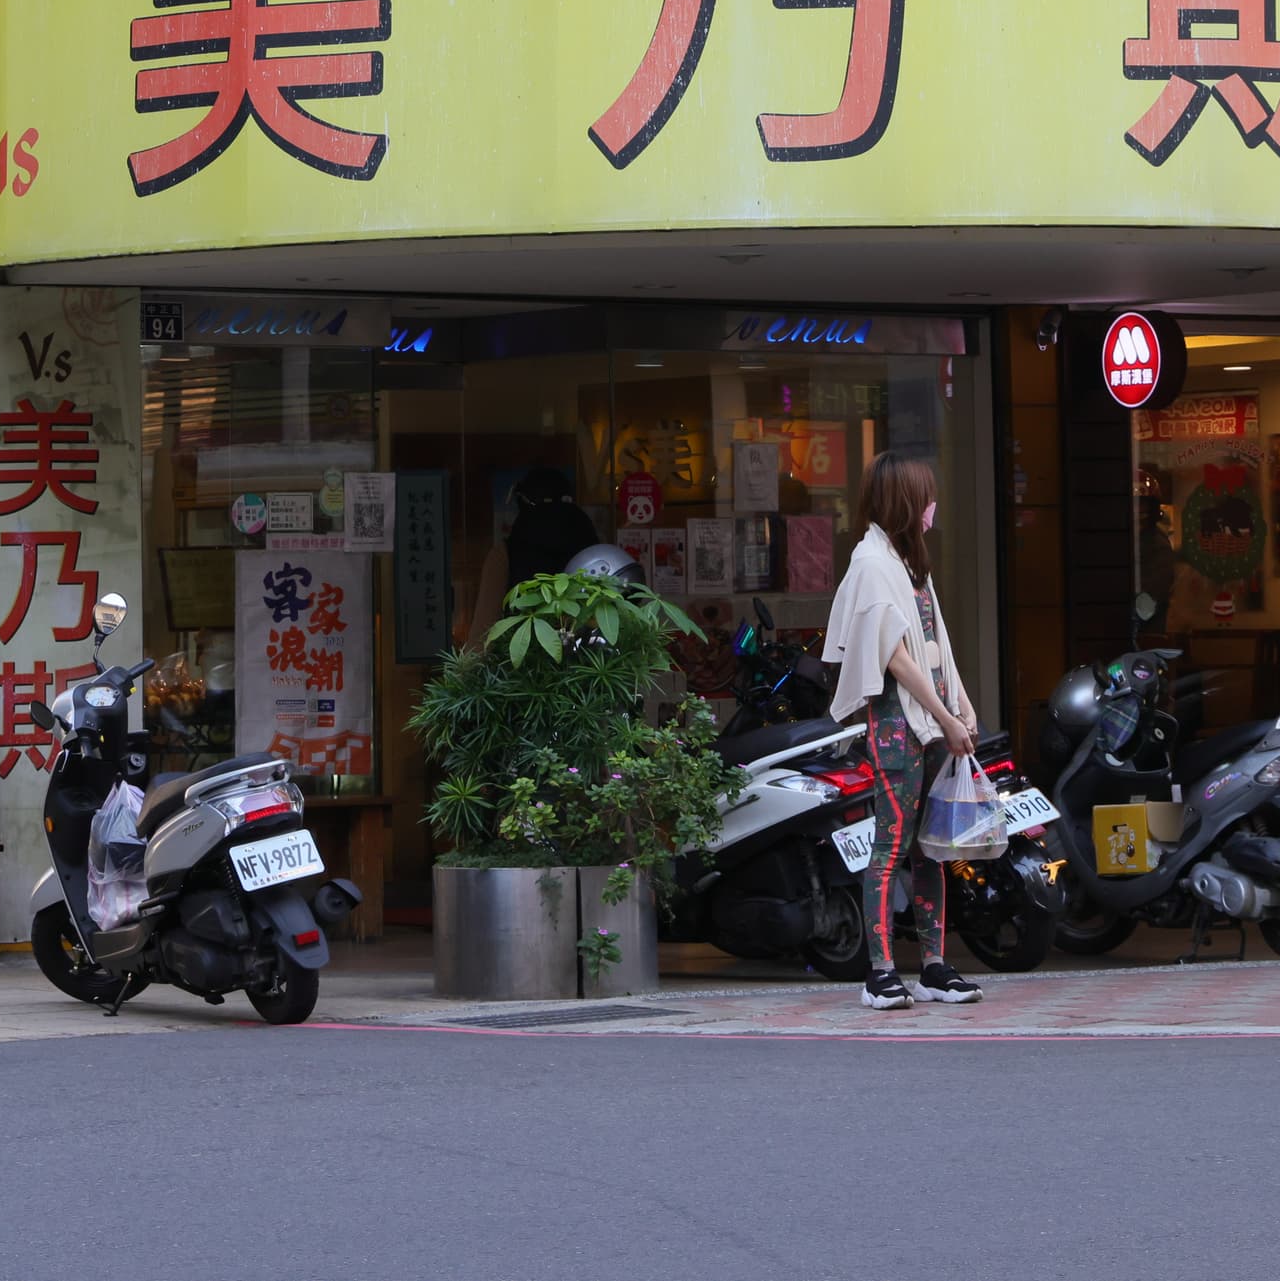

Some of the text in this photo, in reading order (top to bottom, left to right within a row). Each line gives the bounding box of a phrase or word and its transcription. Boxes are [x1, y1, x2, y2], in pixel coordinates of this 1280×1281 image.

[151, 318, 176, 339] 94
[1110, 368, 1153, 387] 摩斯漢堡
